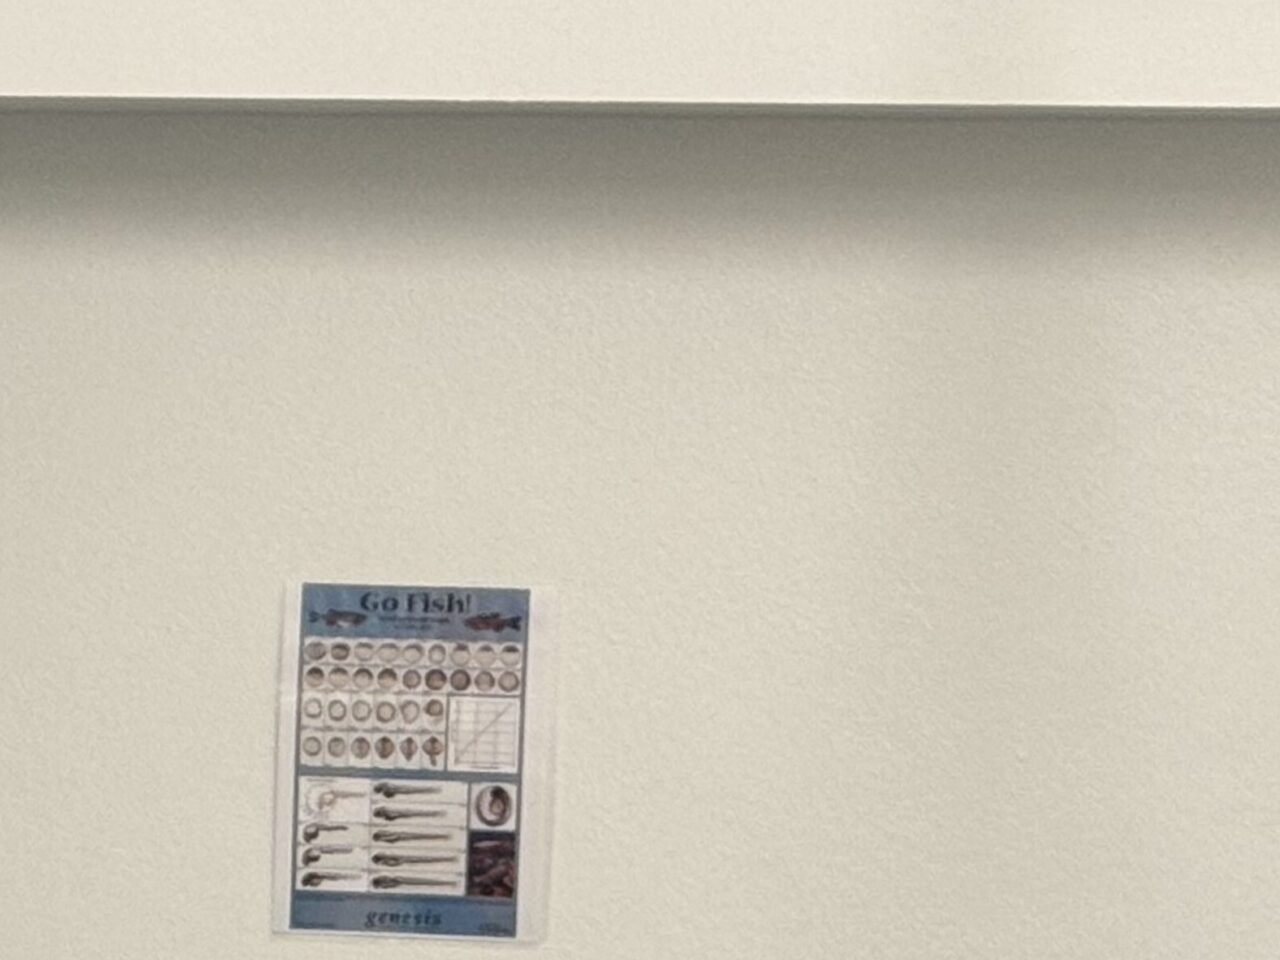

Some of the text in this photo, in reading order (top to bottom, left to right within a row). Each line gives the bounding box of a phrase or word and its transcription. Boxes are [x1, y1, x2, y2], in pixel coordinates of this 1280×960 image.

[360, 591, 472, 613] Go Fish!
[365, 909, 442, 928] genesis
